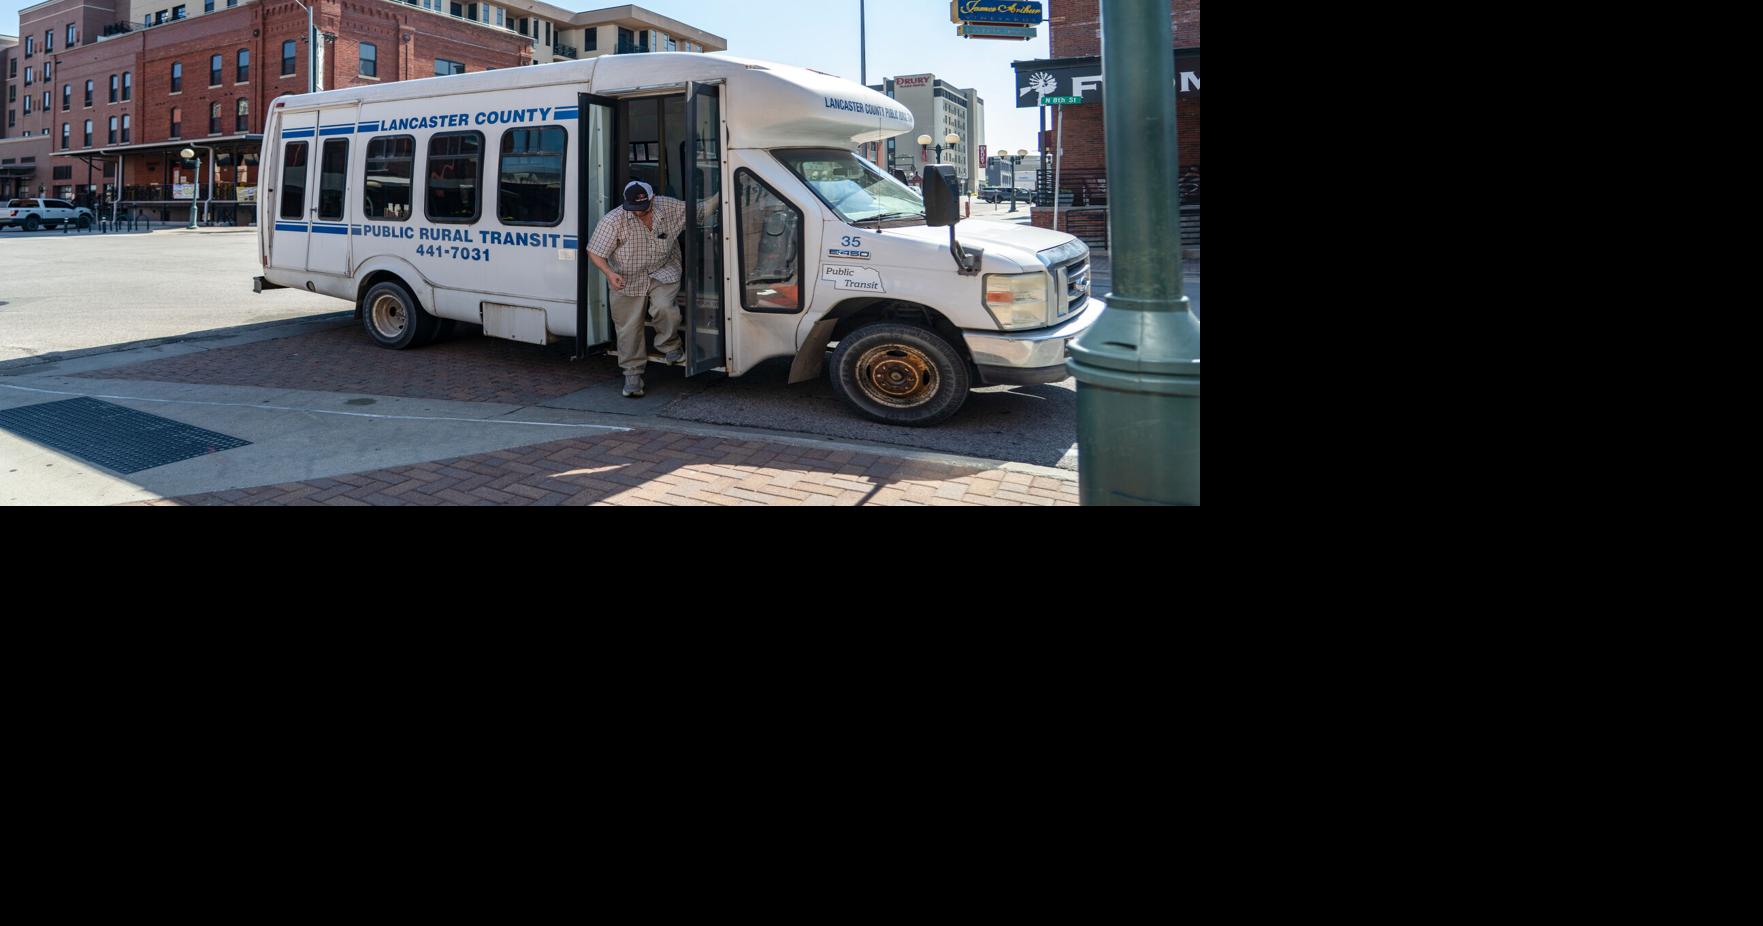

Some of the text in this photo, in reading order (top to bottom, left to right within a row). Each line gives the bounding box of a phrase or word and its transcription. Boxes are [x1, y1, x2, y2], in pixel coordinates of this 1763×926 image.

[896, 76, 929, 85] DRURY
[1045, 96, 1051, 104] N
[824, 97, 864, 113] LANCASTER
[864, 103, 885, 117] COUNTY
[380, 107, 552, 132] LANCASTER COUNTY
[363, 225, 561, 249] PUBLIC RURAL TRANSIT
[841, 235, 861, 247] 35
[416, 244, 490, 262] 441-7031
[826, 267, 854, 276] Public
[845, 280, 878, 289] Transit
